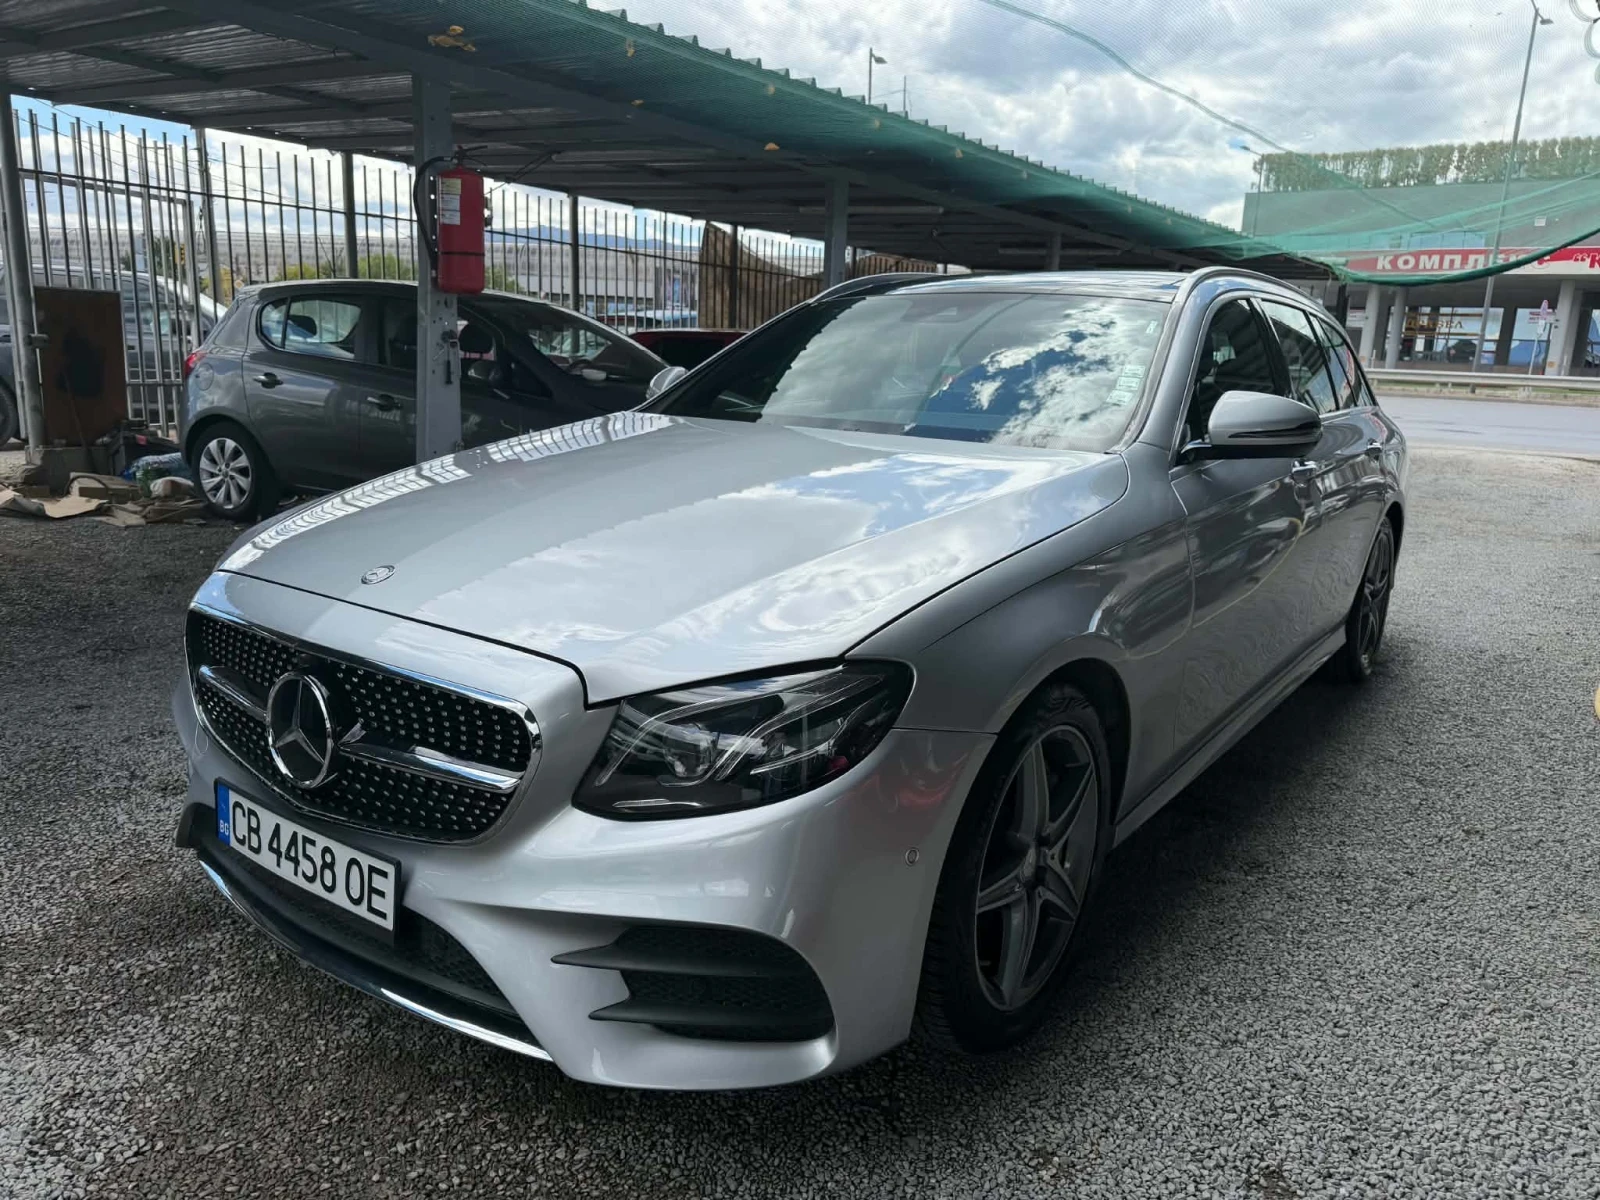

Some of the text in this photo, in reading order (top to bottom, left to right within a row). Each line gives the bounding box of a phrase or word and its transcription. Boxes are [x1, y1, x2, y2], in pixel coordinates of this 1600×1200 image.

[219, 819, 230, 836] BG
[232, 800, 388, 920] CB 4458 OE
